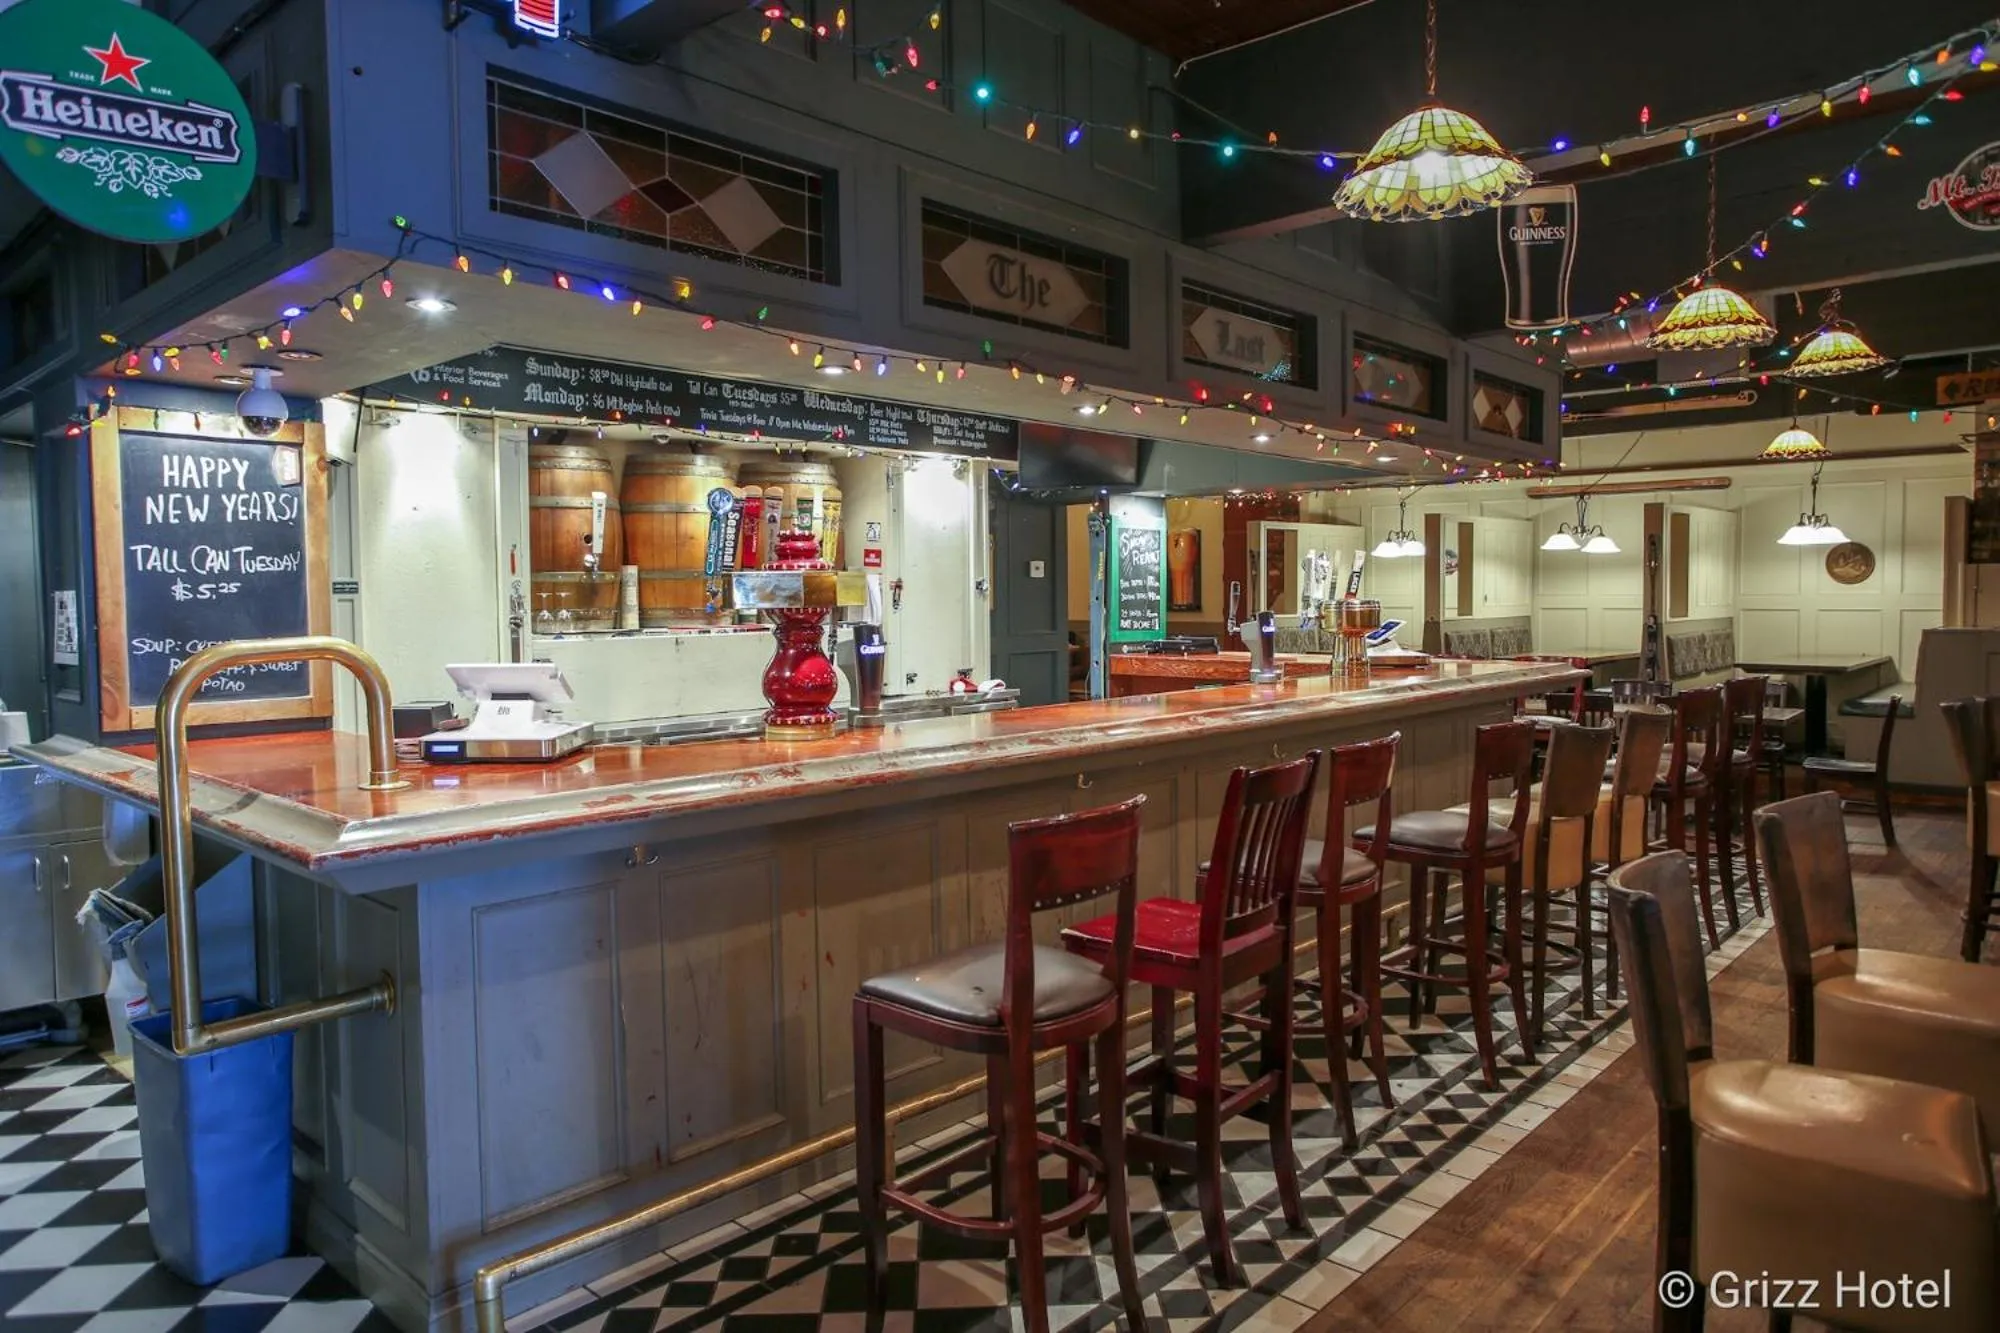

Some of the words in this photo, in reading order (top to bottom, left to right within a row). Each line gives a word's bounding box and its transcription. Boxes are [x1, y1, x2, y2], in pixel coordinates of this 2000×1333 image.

[69, 70, 95, 82] TRADE
[150, 86, 173, 97] MARK
[18, 85, 224, 150] Heineken
[1508, 226, 1566, 241] GUINNESS
[986, 252, 1052, 312] The
[1215, 319, 1267, 365] Last
[443, 373, 465, 384] Food
[468, 377, 502, 388] Services
[467, 366, 509, 381] Beverages
[525, 356, 586, 386] Sunday:
[523, 382, 589, 413] Monday:
[721, 383, 778, 408] Tuesdays
[803, 390, 868, 421] Wednesday:
[916, 408, 963, 430] Thursday:
[162, 454, 249, 491] HAPPY
[146, 493, 210, 525] NEW
[221, 491, 298, 525] YEARS!
[723, 511, 740, 567] Seasonal
[129, 544, 187, 573] TALL
[191, 545, 230, 575] CAN
[232, 546, 300, 574] TUESDAY
[131, 638, 181, 655] SOUP:
